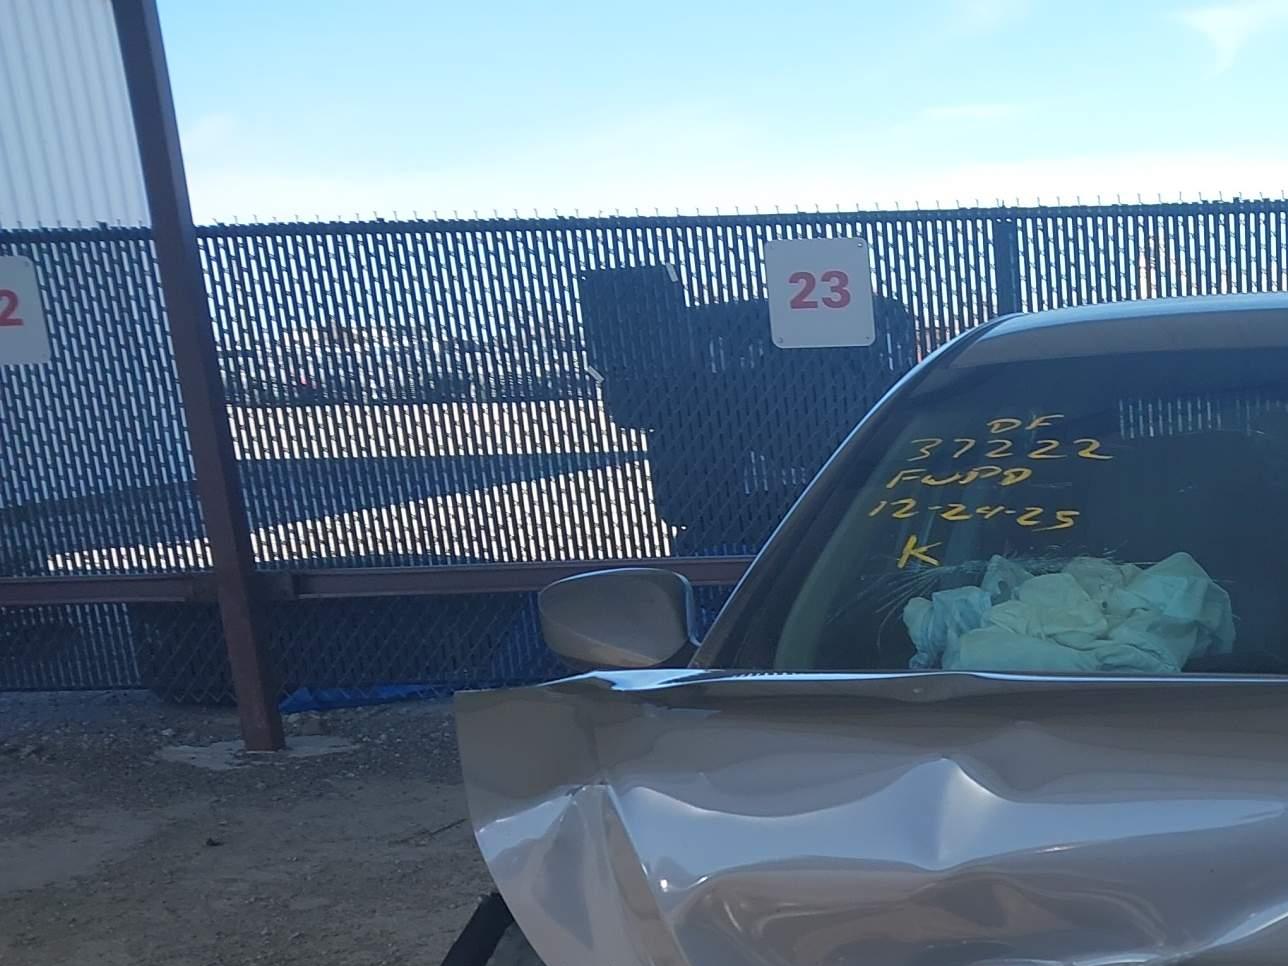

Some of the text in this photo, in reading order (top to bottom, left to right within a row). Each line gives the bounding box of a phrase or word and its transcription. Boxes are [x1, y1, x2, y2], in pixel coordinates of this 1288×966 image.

[788, 270, 851, 310] 23
[906, 438, 1115, 463] 37222
[867, 498, 1081, 532] 12-24-25
[896, 534, 943, 569] K
